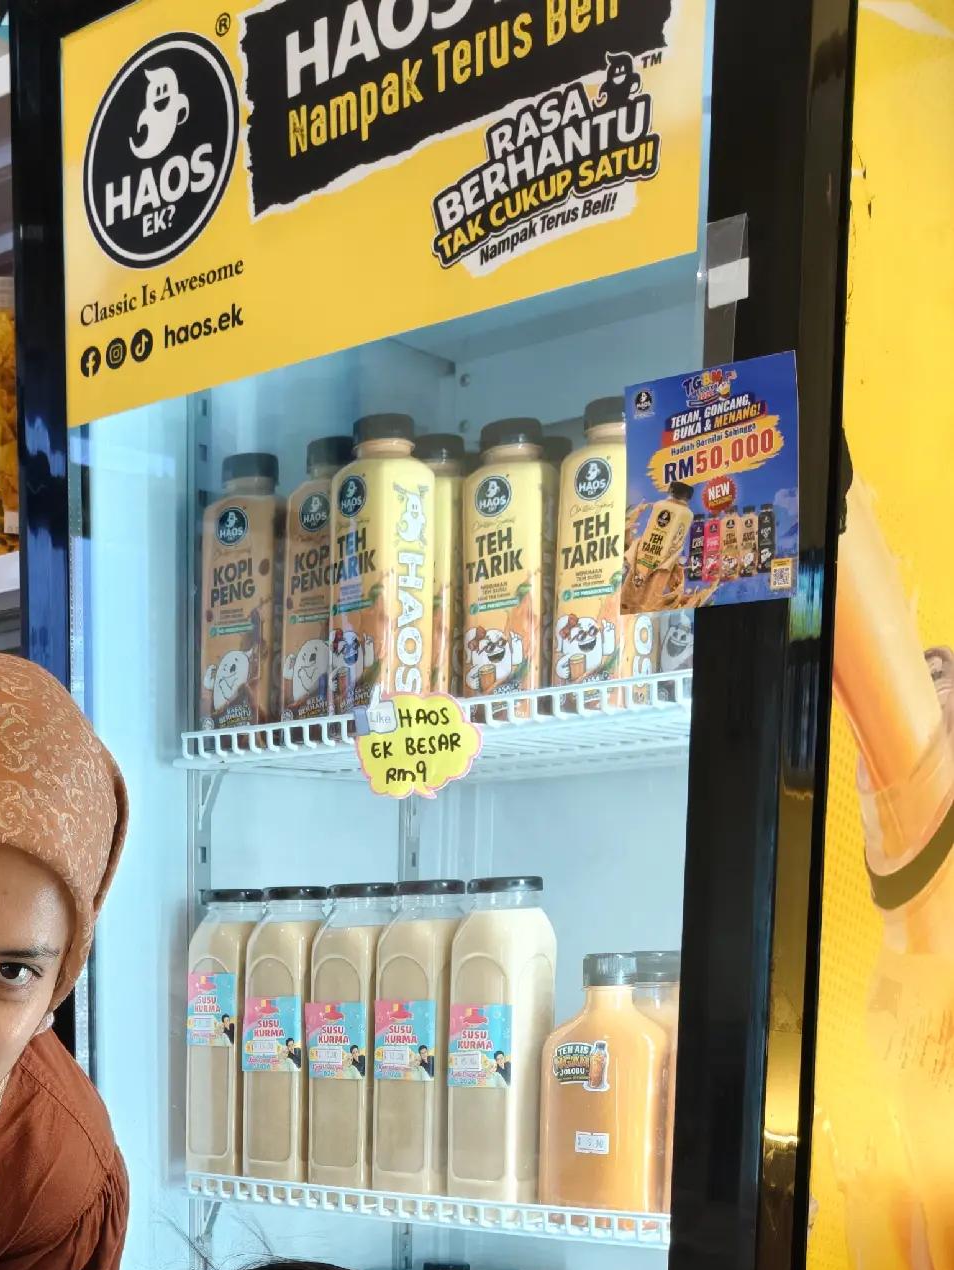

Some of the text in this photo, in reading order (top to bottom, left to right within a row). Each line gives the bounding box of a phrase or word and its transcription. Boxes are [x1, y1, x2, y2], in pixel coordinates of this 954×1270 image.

[288, 56, 424, 157] Nampak
[432, 12, 533, 93] Terus
[490, 89, 586, 160] RASA
[437, 101, 645, 231] BERHANTU
[105, 142, 216, 228] HAOS
[437, 141, 654, 258] TAK CUKUP SATU!
[142, 204, 176, 238] EK?
[479, 191, 618, 267] Nampak Terus Beli!
[80, 259, 244, 326] Classic Is Awesome
[164, 302, 244, 349] haos.ek
[671, 394, 751, 429] TEKAN, GONCANG,
[673, 403, 761, 441] BUKA & MENANG!
[664, 428, 774, 484] RM50,000
[578, 480, 606, 493] HAOS
[708, 481, 730, 502] NEW
[478, 495, 507, 509] HAOS
[303, 511, 327, 524] HAOS
[572, 511, 610, 544] TEH
[219, 527, 244, 539] HAOS
[336, 527, 366, 556] TEH
[476, 526, 512, 560] TEH
[331, 550, 376, 584] TARIK
[466, 548, 523, 584] TARIK
[562, 534, 620, 570] TARIK
[213, 557, 253, 587] KOPI
[210, 577, 255, 607] PENG
[396, 551, 424, 695] HAOS
[369, 712, 391, 724] Like
[398, 707, 450, 728] HAOS
[371, 732, 461, 759] EK BESAR
[194, 1004, 221, 1014] KURMA
[197, 995, 217, 1004] SUSU
[254, 1029, 285, 1038] KURMA
[257, 1020, 280, 1028] SUSU
[321, 1026, 344, 1034] SUSU
[388, 1025, 412, 1034] SUSU
[461, 1030, 488, 1039] SUSU
[318, 1035, 350, 1044] KURMA
[385, 1035, 418, 1044] KURMA
[457, 1040, 493, 1050] KURMA
